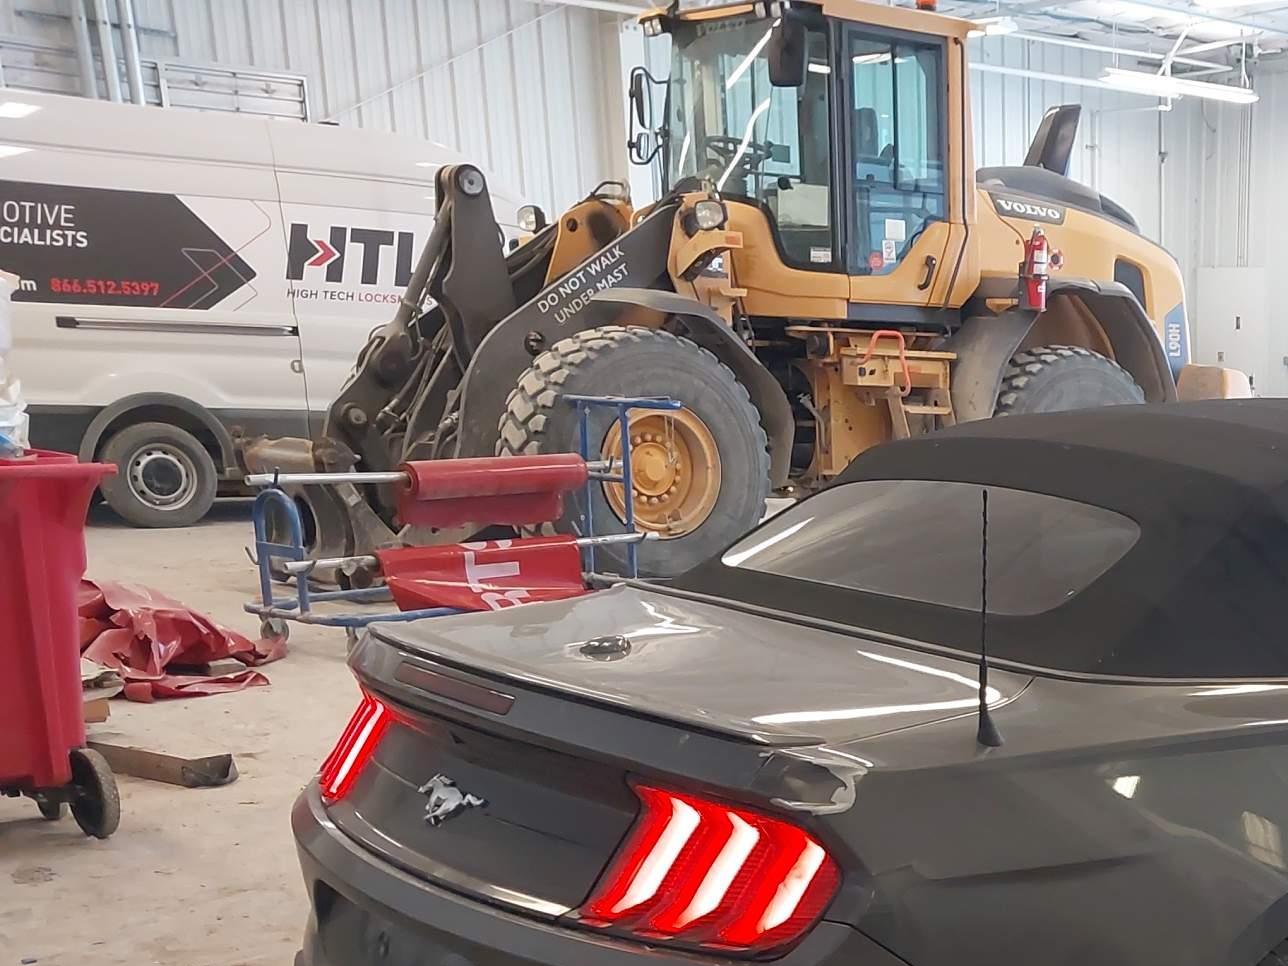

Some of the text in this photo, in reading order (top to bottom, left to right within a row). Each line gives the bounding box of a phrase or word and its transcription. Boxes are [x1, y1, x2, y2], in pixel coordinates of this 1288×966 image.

[997, 199, 1060, 219] VOLVO
[0, 226, 88, 248] CIALISTS
[51, 277, 160, 296] 866.512.5397
[537, 244, 625, 313] DO NOT WALK
[596, 263, 629, 291] MAST
[287, 288, 318, 299] HIGH
[323, 290, 354, 301] TECH
[1168, 323, 1181, 357] L90H
